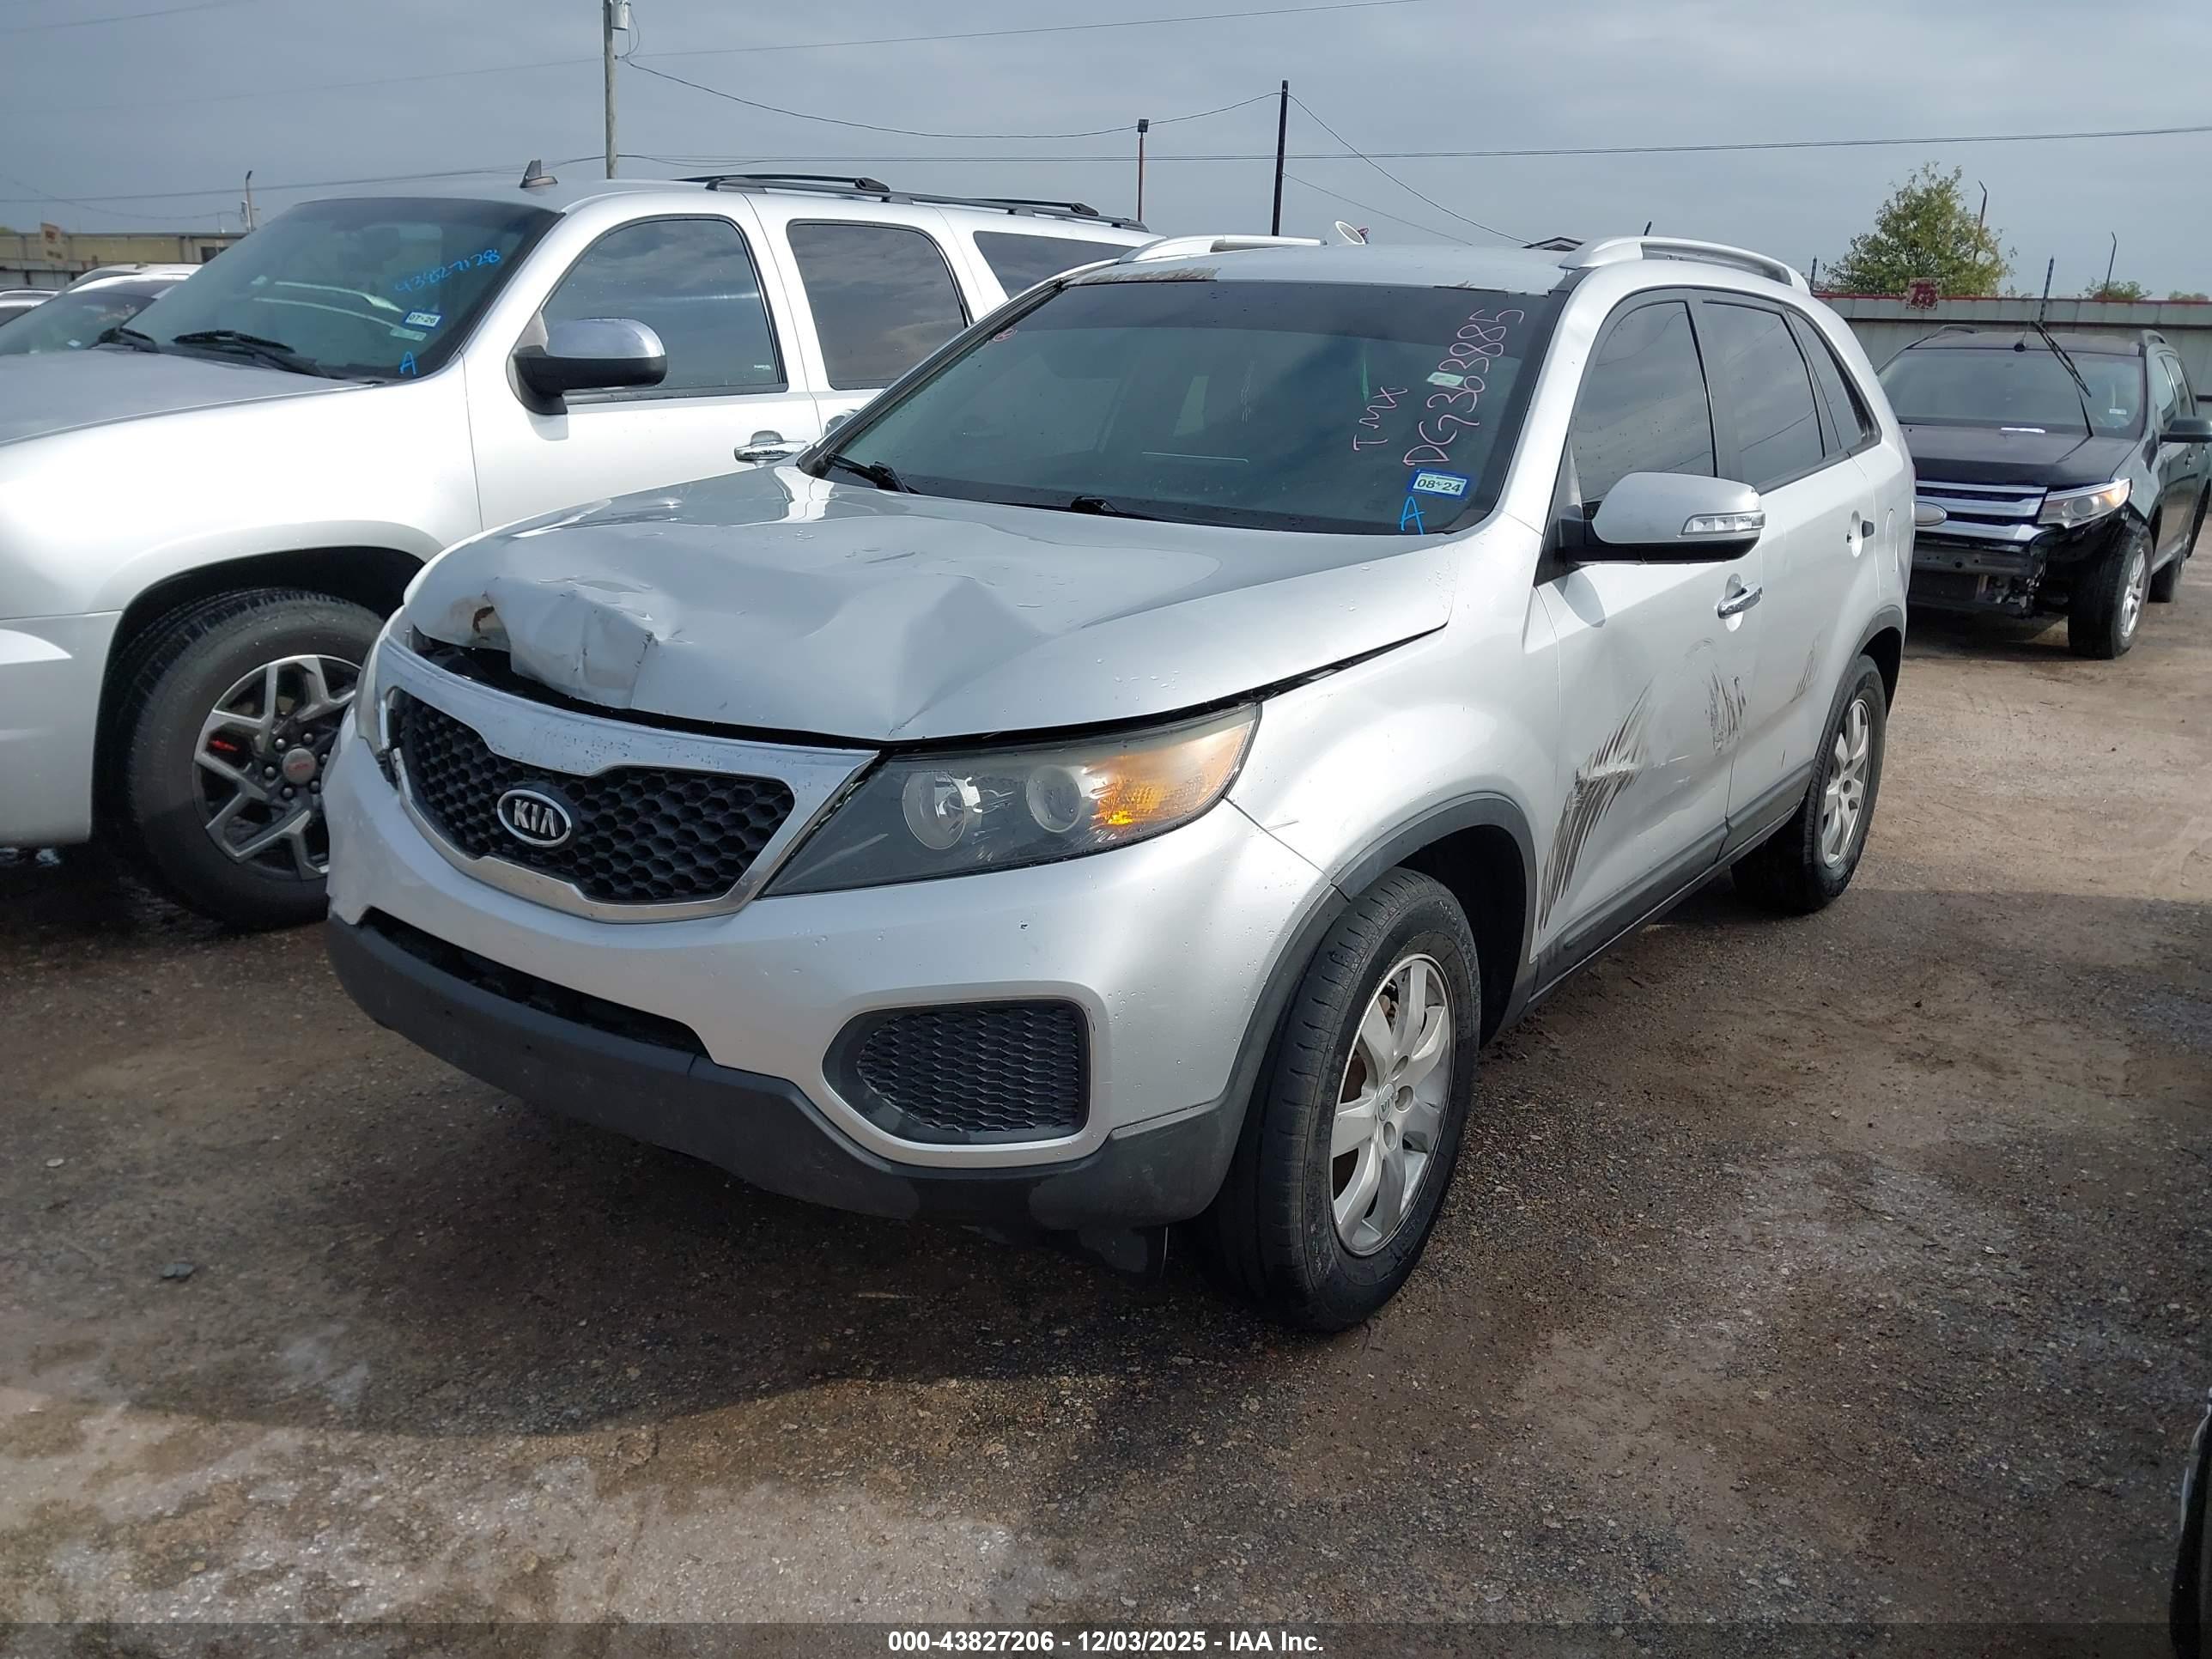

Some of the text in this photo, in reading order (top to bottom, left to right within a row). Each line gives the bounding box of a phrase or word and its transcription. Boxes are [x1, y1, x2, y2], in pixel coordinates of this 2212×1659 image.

[399, 350, 417, 375] A
[1400, 495, 1425, 536] A
[514, 799, 556, 837] KIA
